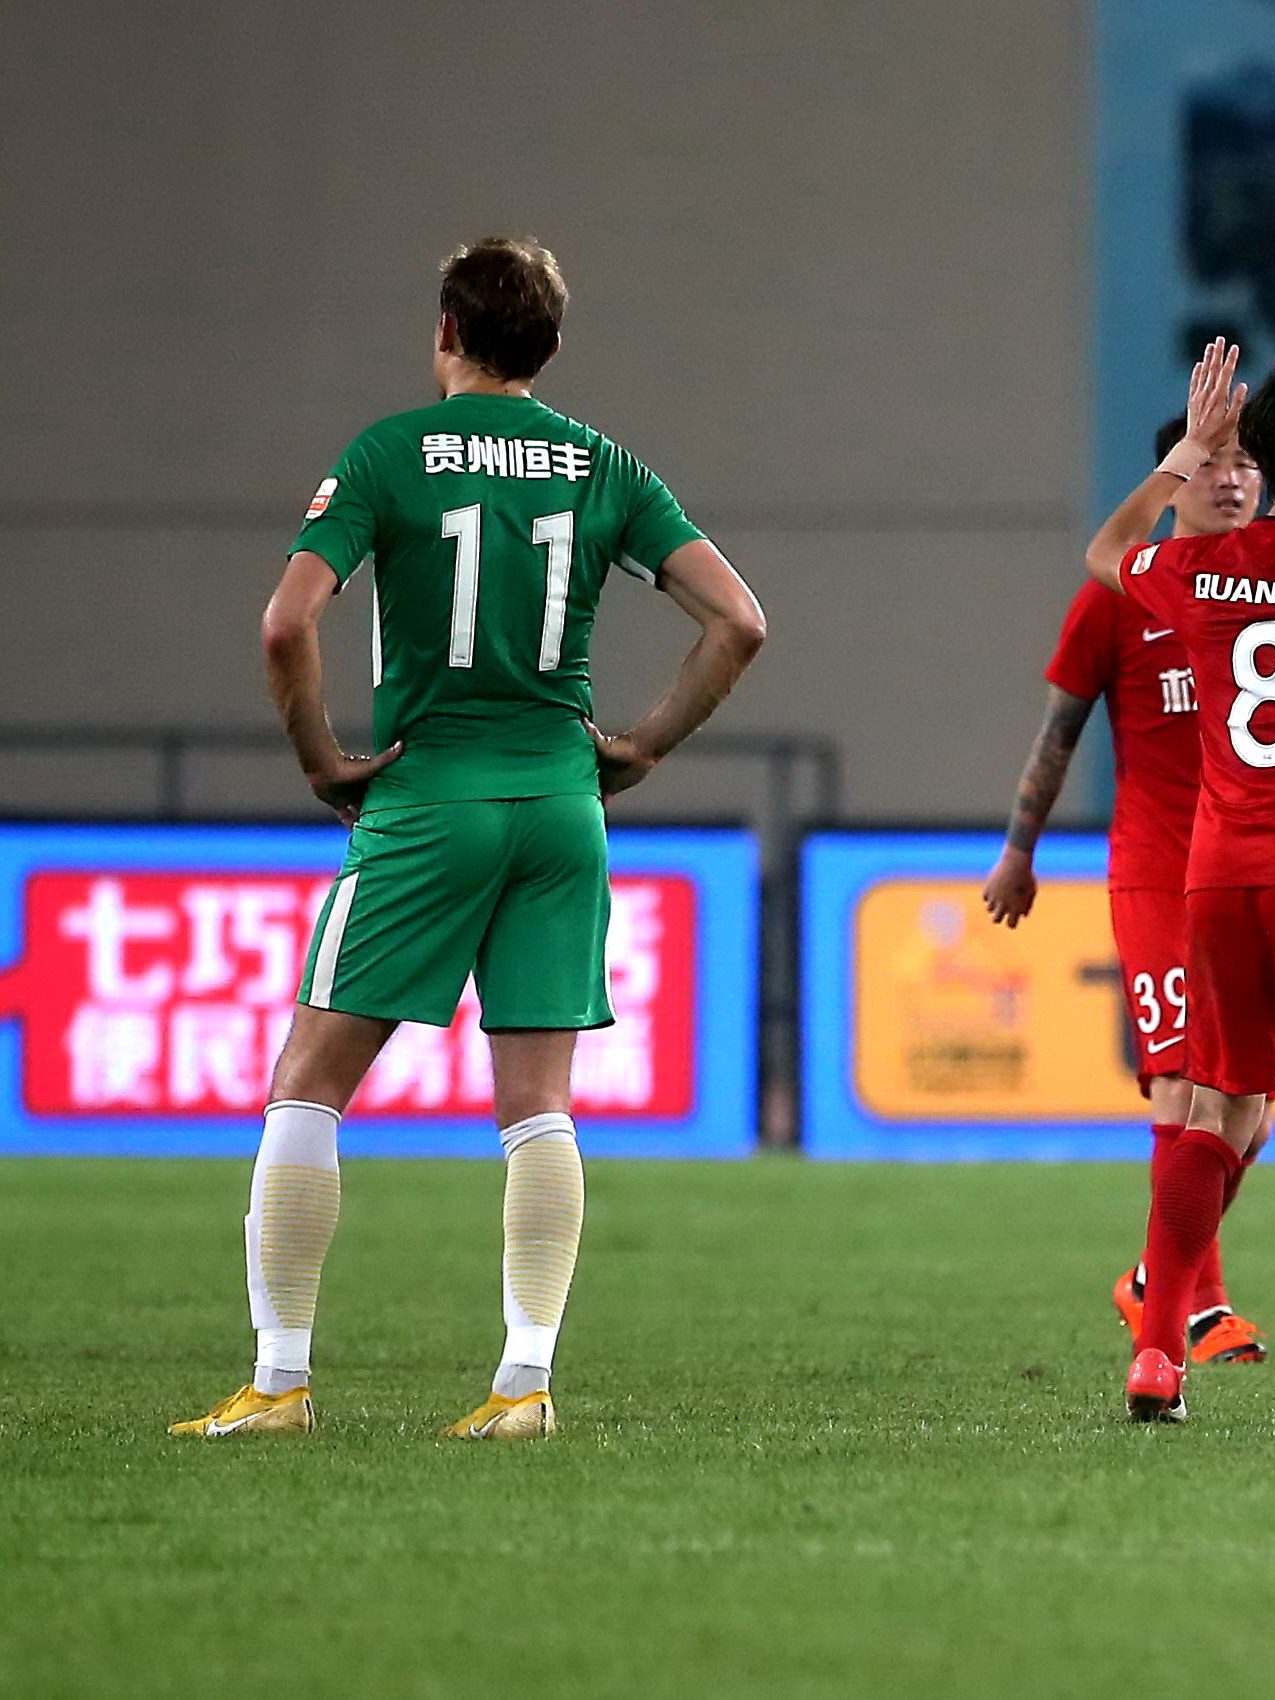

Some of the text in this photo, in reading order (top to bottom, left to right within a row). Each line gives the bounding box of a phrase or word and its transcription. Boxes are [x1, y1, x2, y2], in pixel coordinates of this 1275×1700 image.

[420, 433, 592, 482] 贵州恒丰
[441, 503, 574, 672] 11
[1133, 966, 1186, 1034] 39
